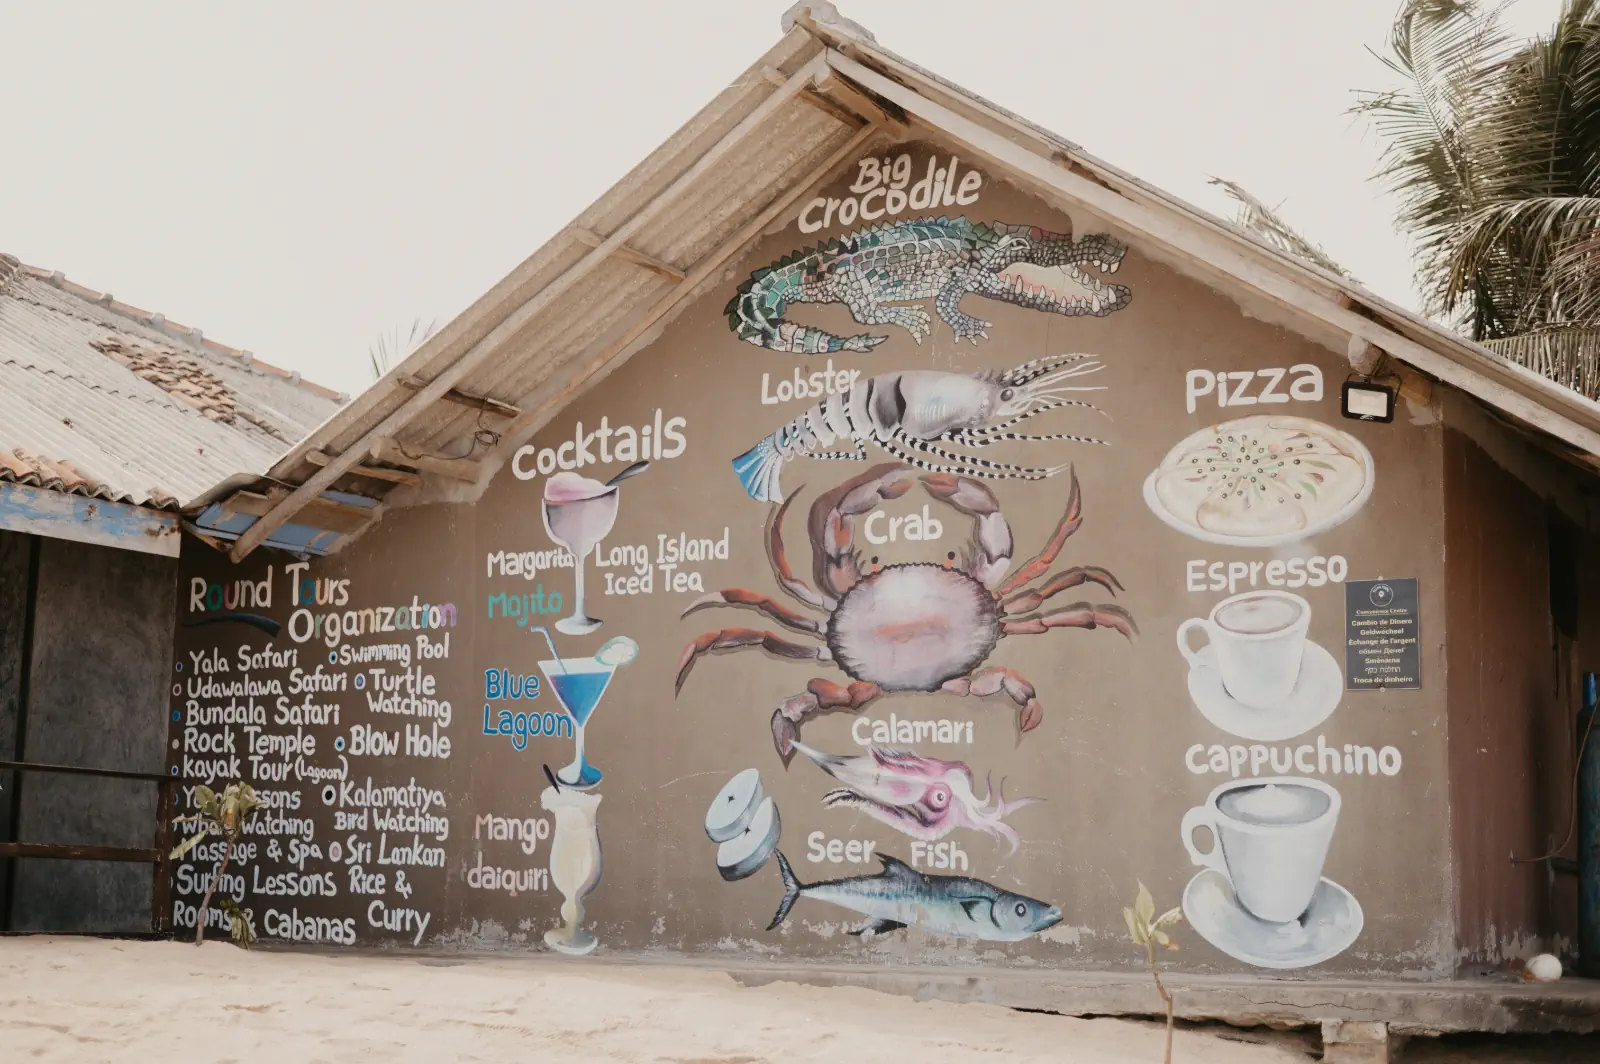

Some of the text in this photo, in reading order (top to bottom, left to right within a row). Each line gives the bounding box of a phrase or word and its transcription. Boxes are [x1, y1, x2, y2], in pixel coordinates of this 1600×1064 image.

[849, 154, 911, 194] Big
[761, 358, 861, 405] Lobster
[1186, 363, 1323, 414] Pizza
[511, 407, 687, 480] Cocktails
[864, 504, 943, 545] Crab
[487, 547, 574, 580] Margarita
[595, 526, 729, 575] Long Island
[190, 562, 351, 612] Round Tours
[604, 564, 704, 595] Iced Tea
[1186, 555, 1348, 594] Espresso
[288, 595, 457, 648] Organization
[487, 583, 563, 627] Mojito
[1351, 619, 1378, 627] Cambio
[339, 632, 450, 668] Swimming Pool
[1360, 628, 1404, 636] Geldwechsel
[189, 642, 298, 676] Yala Safari
[187, 664, 347, 699] Udawalawa Safari
[369, 665, 436, 695] Turtle
[485, 668, 540, 700] Blue
[1384, 675, 1413, 683] dinheiro
[185, 694, 340, 727] Bundala Safari
[366, 692, 452, 728] Watching
[483, 704, 573, 751] Lagoon
[184, 725, 316, 759] Rock Temple
[349, 722, 451, 759] Blow Hole
[852, 713, 974, 745] Calamari
[249, 755, 292, 782] Tour
[295, 754, 348, 784] (Lagoon)
[339, 777, 446, 813] Kalamatiya
[241, 809, 314, 842] Watching
[334, 808, 449, 841] Bird Watching
[475, 813, 550, 855] Mango
[267, 838, 283, 864] &
[288, 839, 323, 871] Spa
[345, 833, 445, 867] Sri Lankan
[807, 830, 969, 872] Seer Fish
[177, 862, 337, 903] Surfing Lessons
[349, 865, 412, 899] Rice &
[467, 852, 548, 897] daiquiri
[264, 907, 356, 945] Cabanas
[367, 900, 431, 946] Curry
